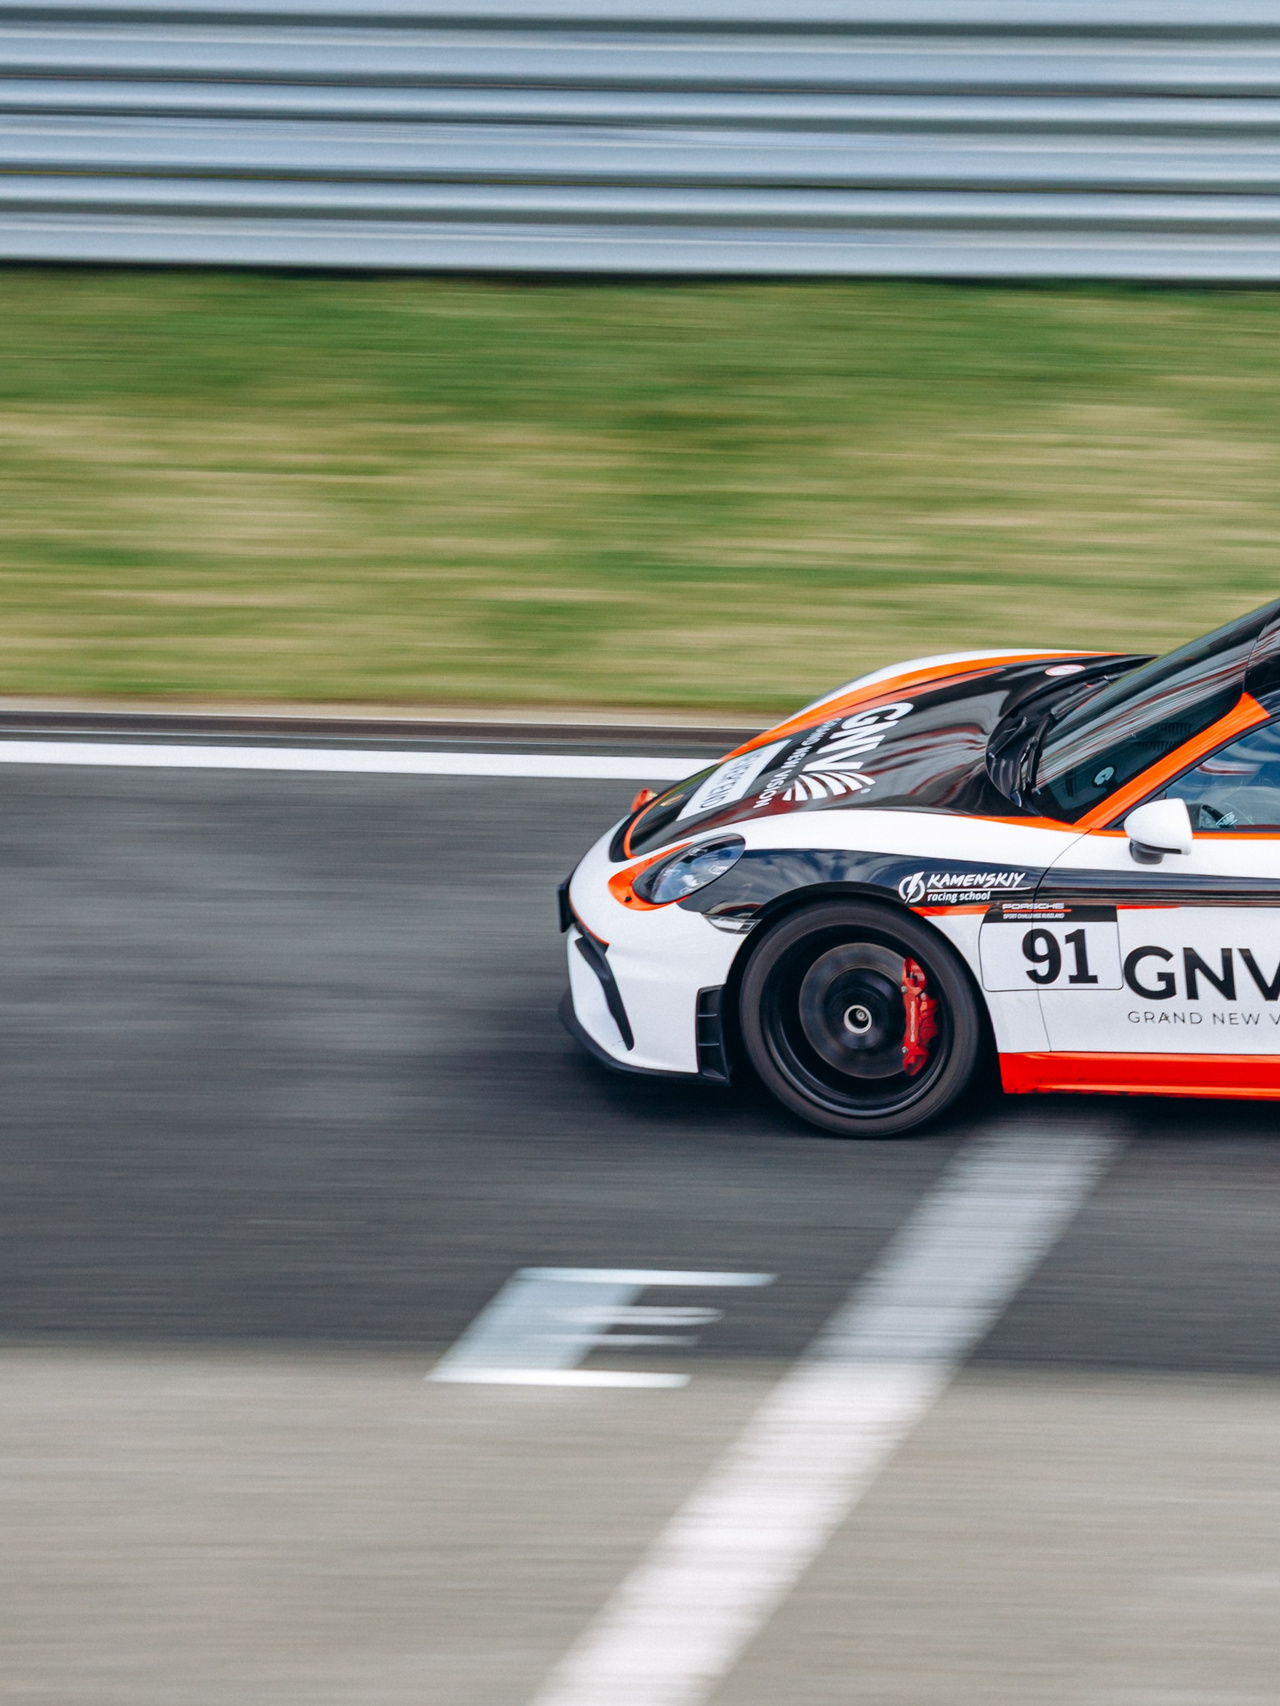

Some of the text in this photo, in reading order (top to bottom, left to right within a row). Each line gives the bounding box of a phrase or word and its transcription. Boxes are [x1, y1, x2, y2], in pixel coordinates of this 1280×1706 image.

[802, 702, 914, 772] GNV
[781, 745, 813, 770] NEW
[753, 769, 793, 809] VISION
[926, 872, 1026, 888] KAMENSKIY
[927, 890, 991, 904] racing school
[1002, 902, 1065, 910] PORSCHE
[1022, 928, 1099, 985] 91
[1127, 1010, 1203, 1025] GRAND
[1212, 1012, 1262, 1026] NEW
